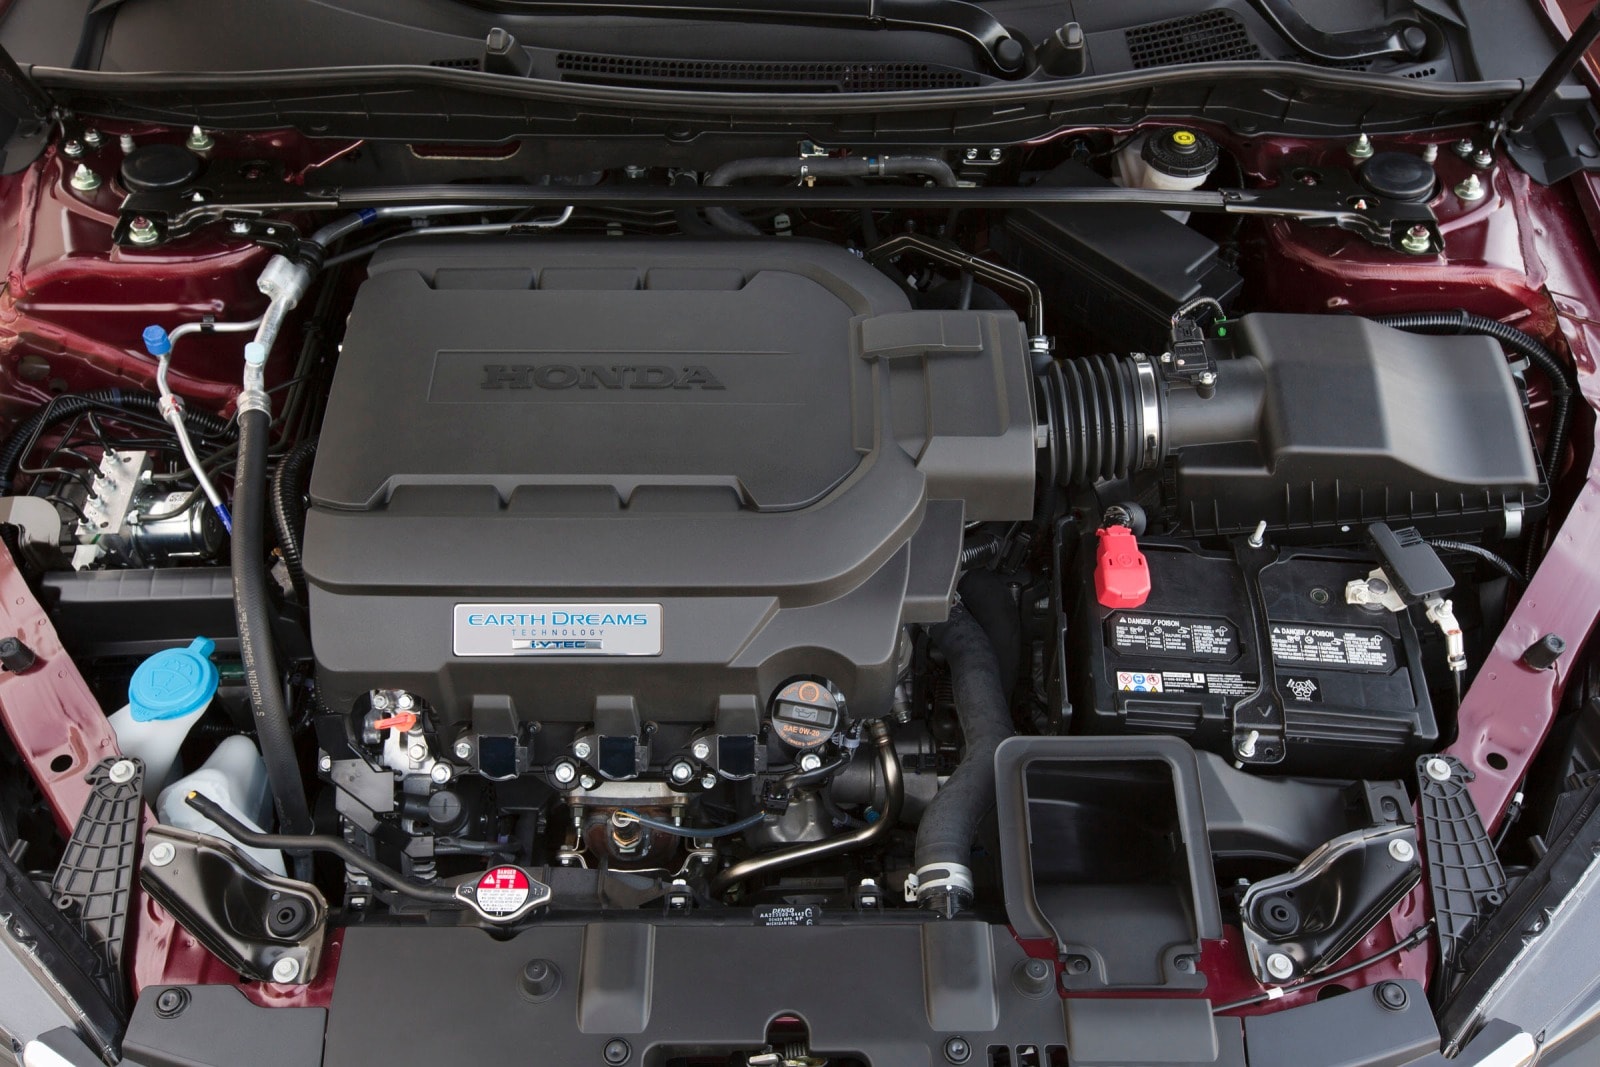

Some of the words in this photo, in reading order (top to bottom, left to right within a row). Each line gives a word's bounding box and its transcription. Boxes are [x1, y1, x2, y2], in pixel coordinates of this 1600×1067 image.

[481, 364, 726, 390] HONDA
[468, 614, 545, 625] EARTH
[552, 611, 647, 625] DREAMS
[1127, 617, 1152, 626] DANGER
[1158, 619, 1180, 627] POISON
[1281, 628, 1305, 636] DANGER
[783, 724, 799, 734] SAE
[799, 727, 820, 738] 0W-20
